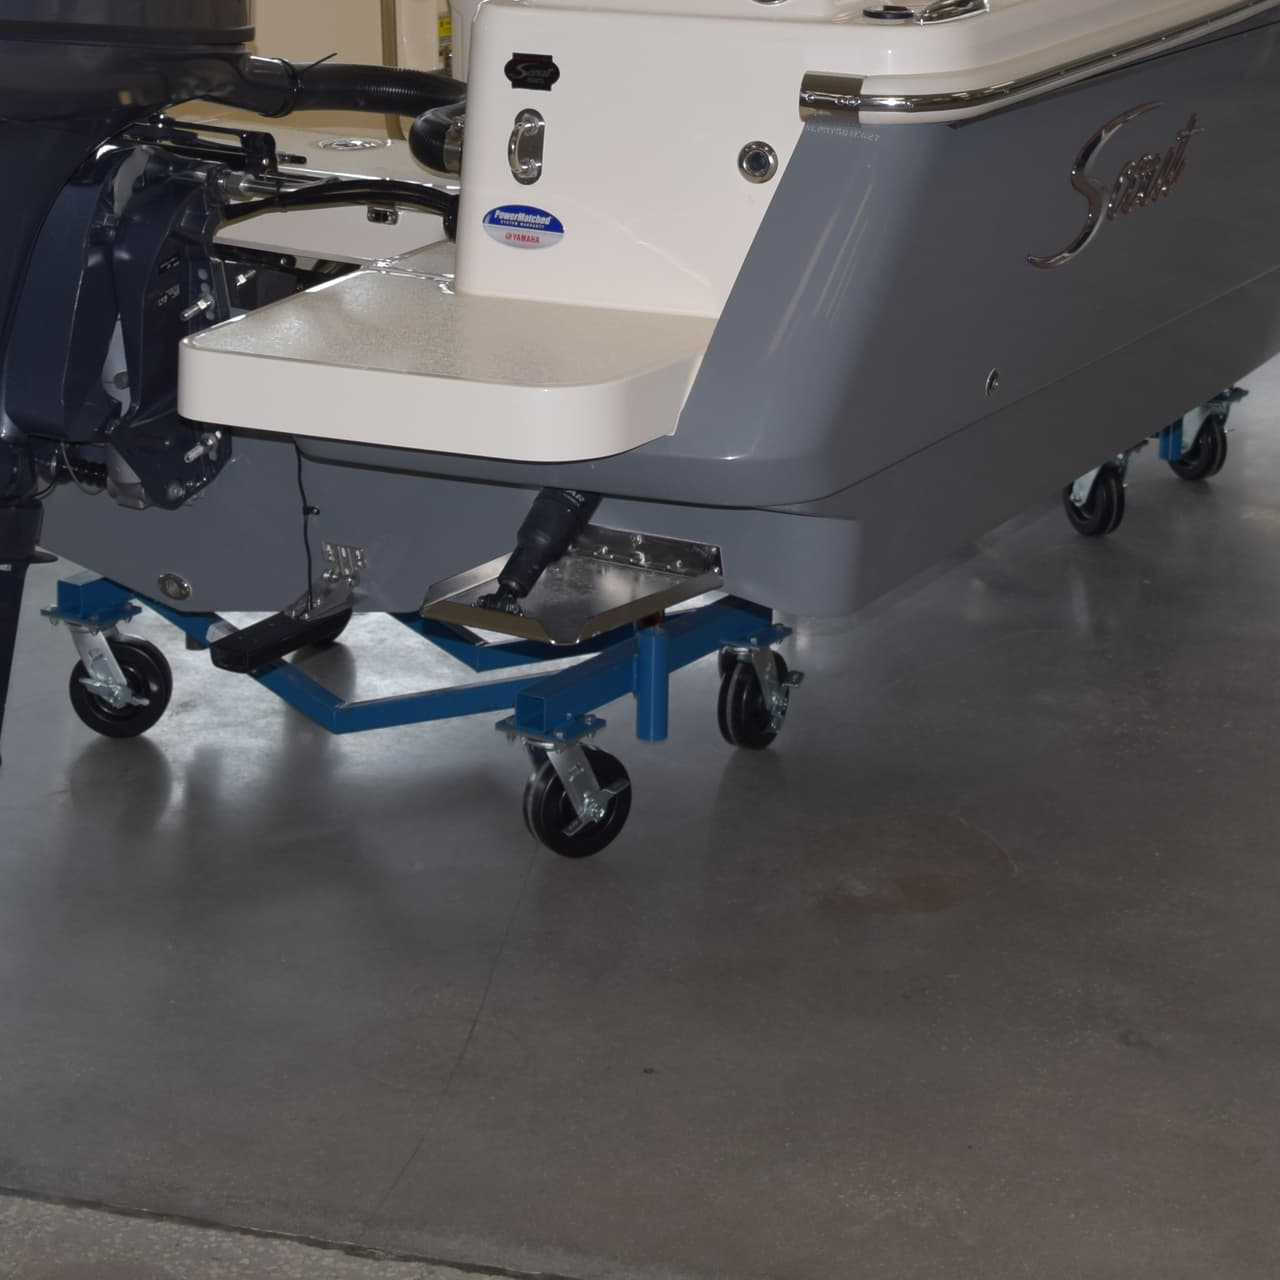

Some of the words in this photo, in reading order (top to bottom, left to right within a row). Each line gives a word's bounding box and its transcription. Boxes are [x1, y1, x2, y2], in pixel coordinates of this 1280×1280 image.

[1026, 100, 1206, 269] Scout
[494, 209, 552, 225] PowerMatched
[512, 233, 540, 244] YAMAHA
